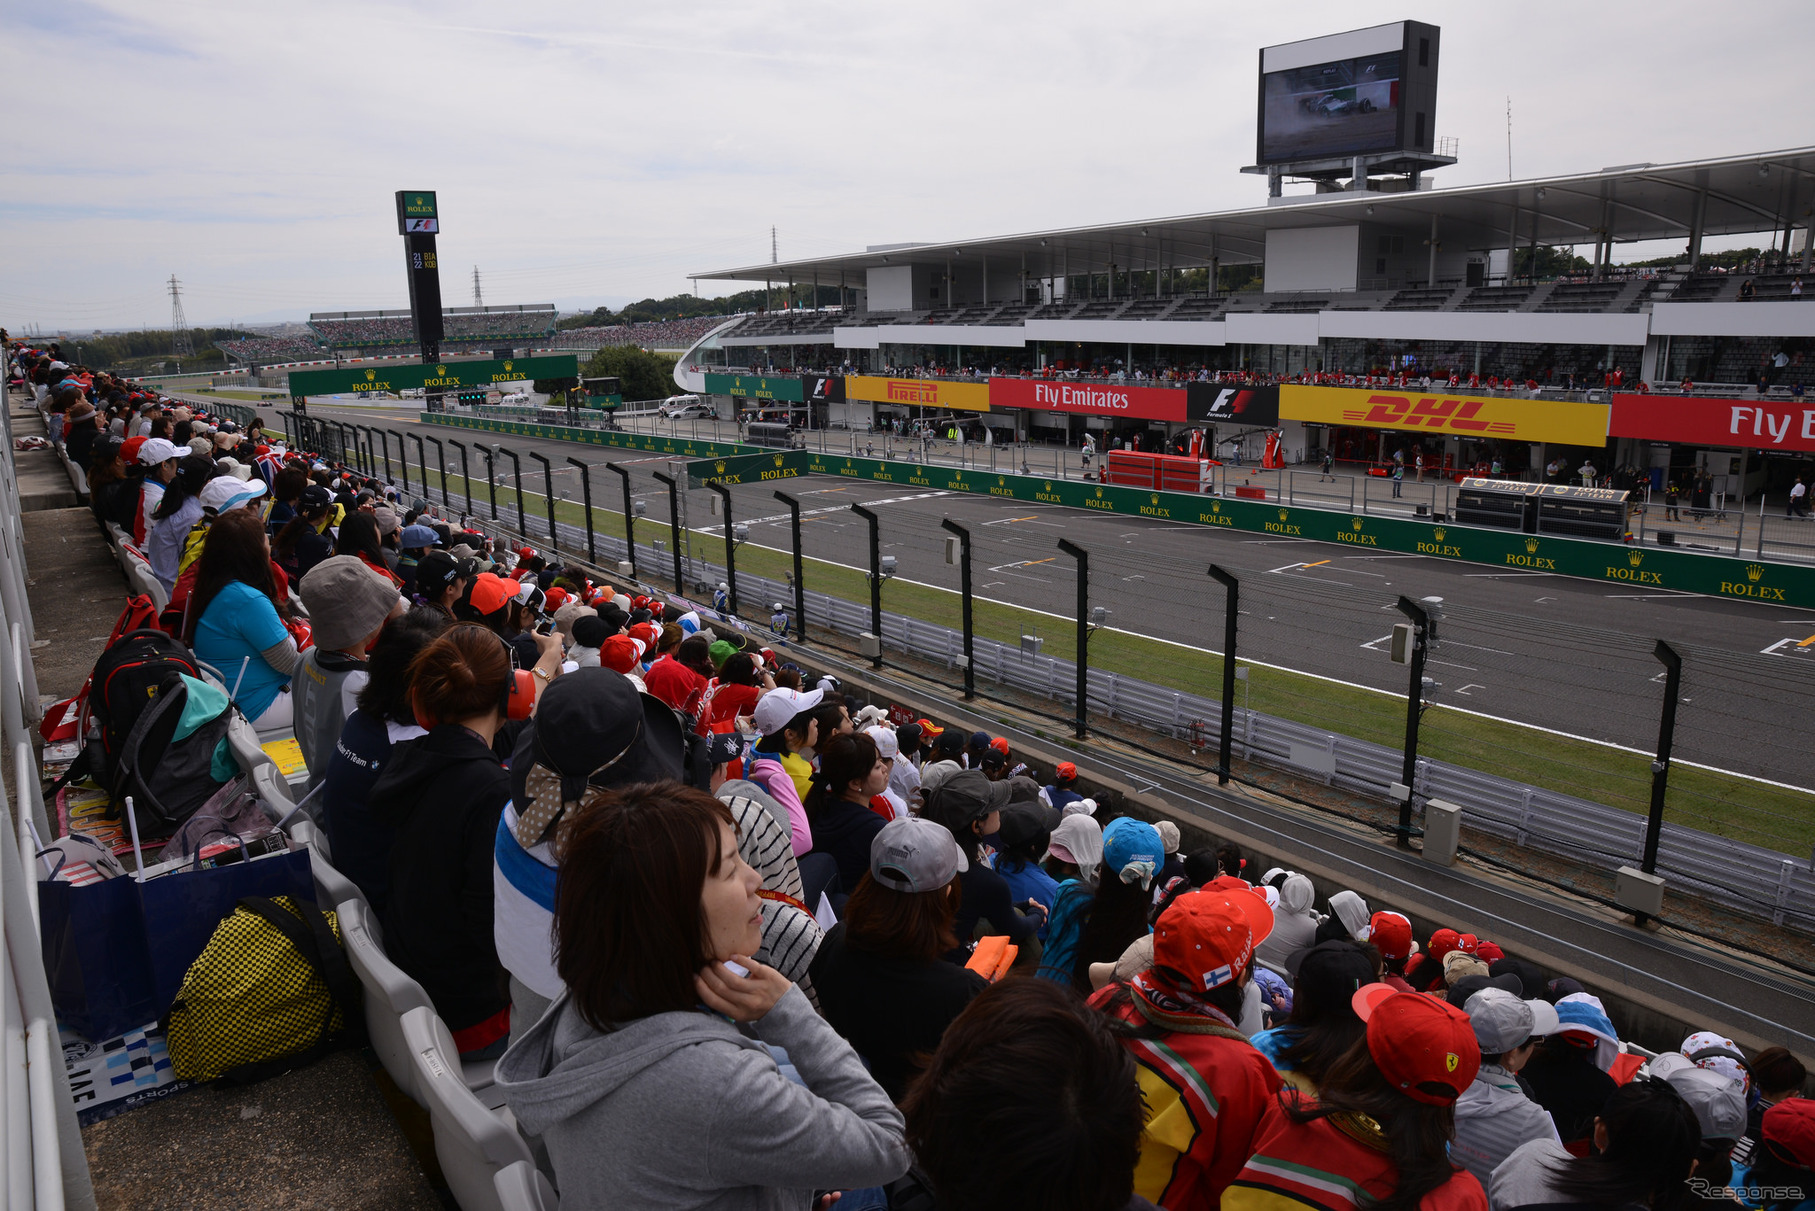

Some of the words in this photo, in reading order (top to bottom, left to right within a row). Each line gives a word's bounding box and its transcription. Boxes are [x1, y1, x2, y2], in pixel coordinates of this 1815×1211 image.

[412, 219, 433, 231] F1
[413, 252, 421, 260] 21
[424, 252, 436, 260] BIA
[414, 261, 422, 269] 22
[424, 377, 461, 387] ROLEX
[491, 372, 527, 382] ROLEX
[352, 381, 391, 392] ROLEX
[730, 387, 747, 396] ROLEX
[813, 378, 835, 396] F1
[887, 381, 938, 403] PIRELLI
[755, 390, 773, 399] ROLEX
[1035, 384, 1059, 407] Fly
[1062, 386, 1129, 409] Emirates
[1209, 388, 1256, 414] F1
[1364, 395, 1491, 432] DHL
[1729, 406, 1792, 444] Fly
[760, 467, 798, 481] ROLEX
[809, 464, 826, 473] ROLEX
[840, 467, 858, 476] ROLEX
[873, 471, 893, 481] ROLEX
[909, 476, 930, 486] ROLEX
[948, 481, 970, 491] ROLEX
[990, 486, 1014, 497] ROLEX
[1036, 492, 1061, 503] ROLEX
[1085, 498, 1113, 510] ROLEX
[1140, 505, 1170, 518] ROLEX
[1200, 513, 1233, 526] ROLEX
[1265, 521, 1302, 535] ROLEX
[1337, 531, 1377, 546] ROLEX
[1417, 542, 1462, 557] ROLEX
[1506, 553, 1556, 570] ROLEX
[1606, 566, 1662, 586] ROLEX
[1720, 581, 1786, 601] ROLEX
[350, 752, 367, 767] Team
[125, 1081, 189, 1104] SPORTS
